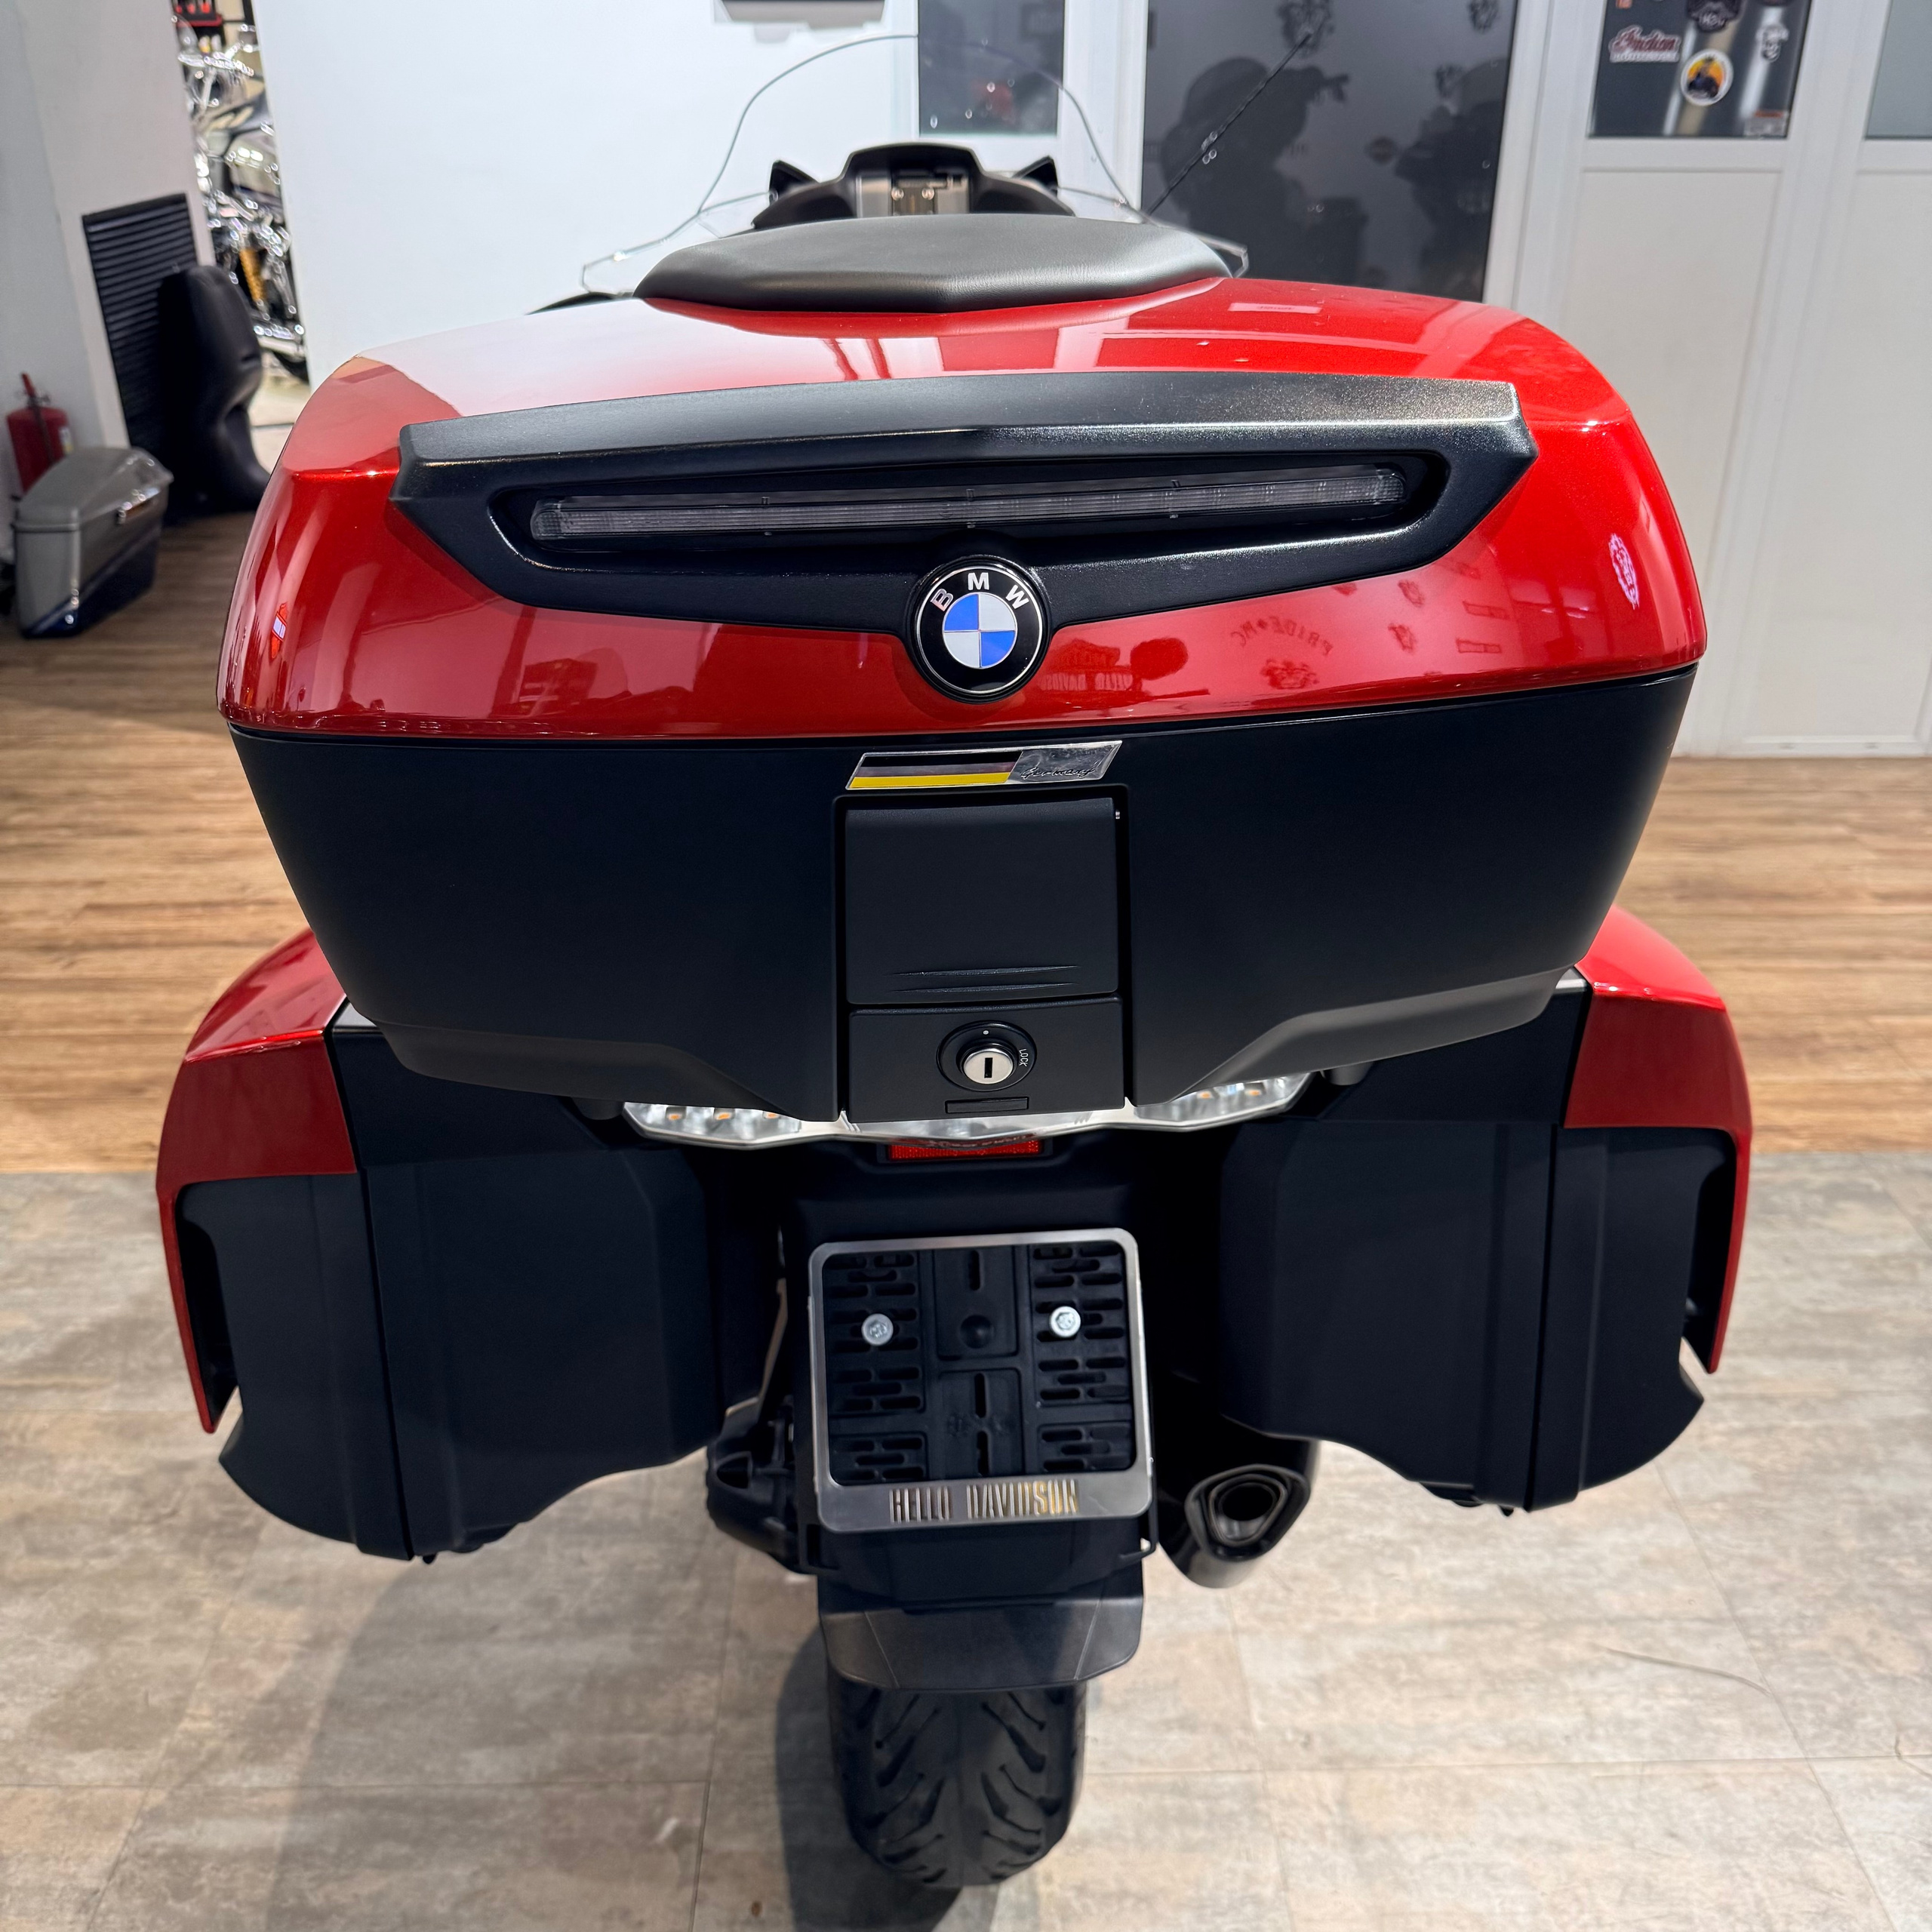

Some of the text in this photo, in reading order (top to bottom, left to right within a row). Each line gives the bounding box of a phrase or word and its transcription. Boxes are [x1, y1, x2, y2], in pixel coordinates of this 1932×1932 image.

[931, 572, 1030, 612] BMW
[1020, 766, 1096, 780] Germany
[1019, 1048, 1029, 1067] LOCK
[965, 1478, 1078, 1520] DAVIDSON
